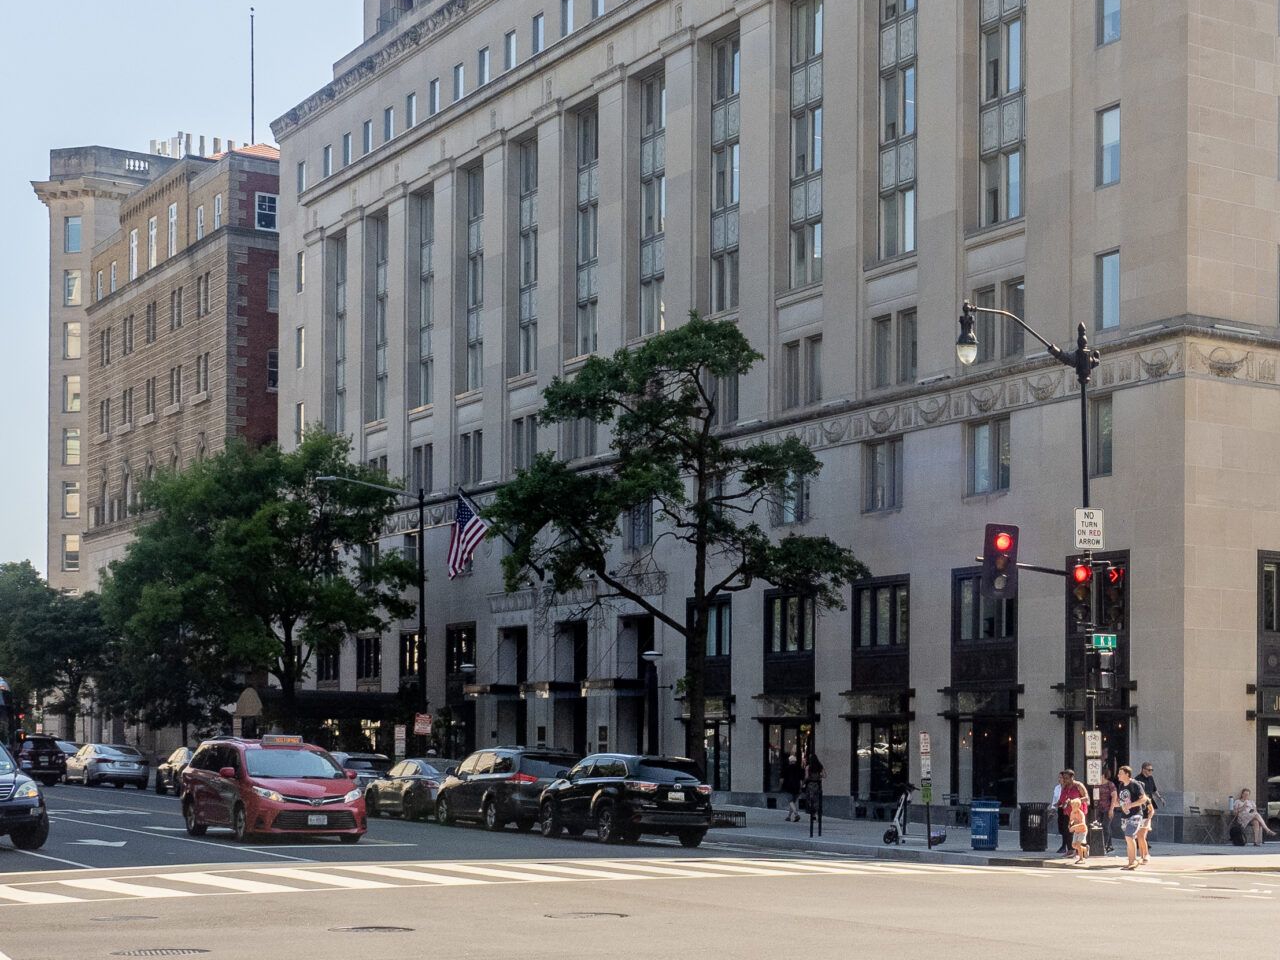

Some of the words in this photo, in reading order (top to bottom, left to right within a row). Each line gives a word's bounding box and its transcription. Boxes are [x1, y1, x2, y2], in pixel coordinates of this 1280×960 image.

[1084, 511, 1094, 519] NO
[1081, 520, 1098, 528] TURN
[1079, 538, 1101, 546] ARROW
[1100, 636, 1105, 646] K
